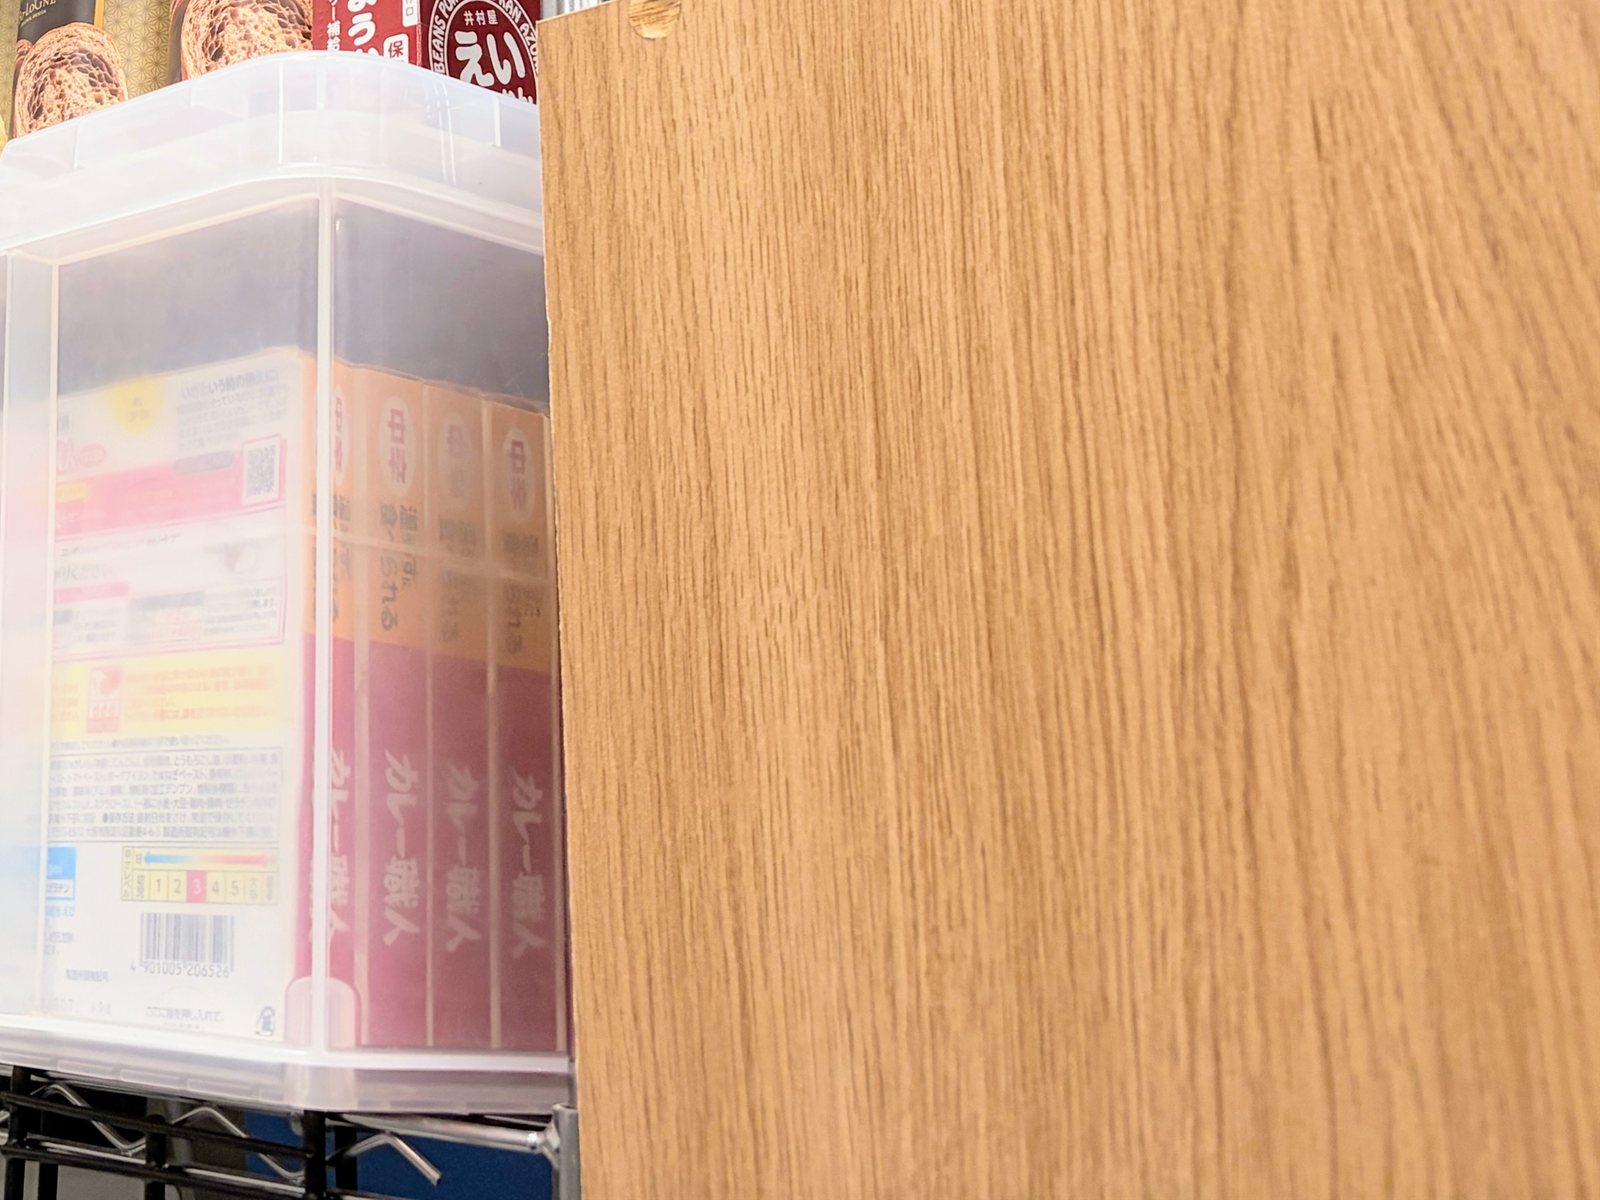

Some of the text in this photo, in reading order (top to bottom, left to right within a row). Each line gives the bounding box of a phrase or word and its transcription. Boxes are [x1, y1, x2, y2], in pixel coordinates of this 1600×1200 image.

[432, 15, 447, 74] BEANS
[463, 9, 499, 26] 井村屋
[454, 30, 527, 87] えい
[383, 748, 422, 947] カレー職人
